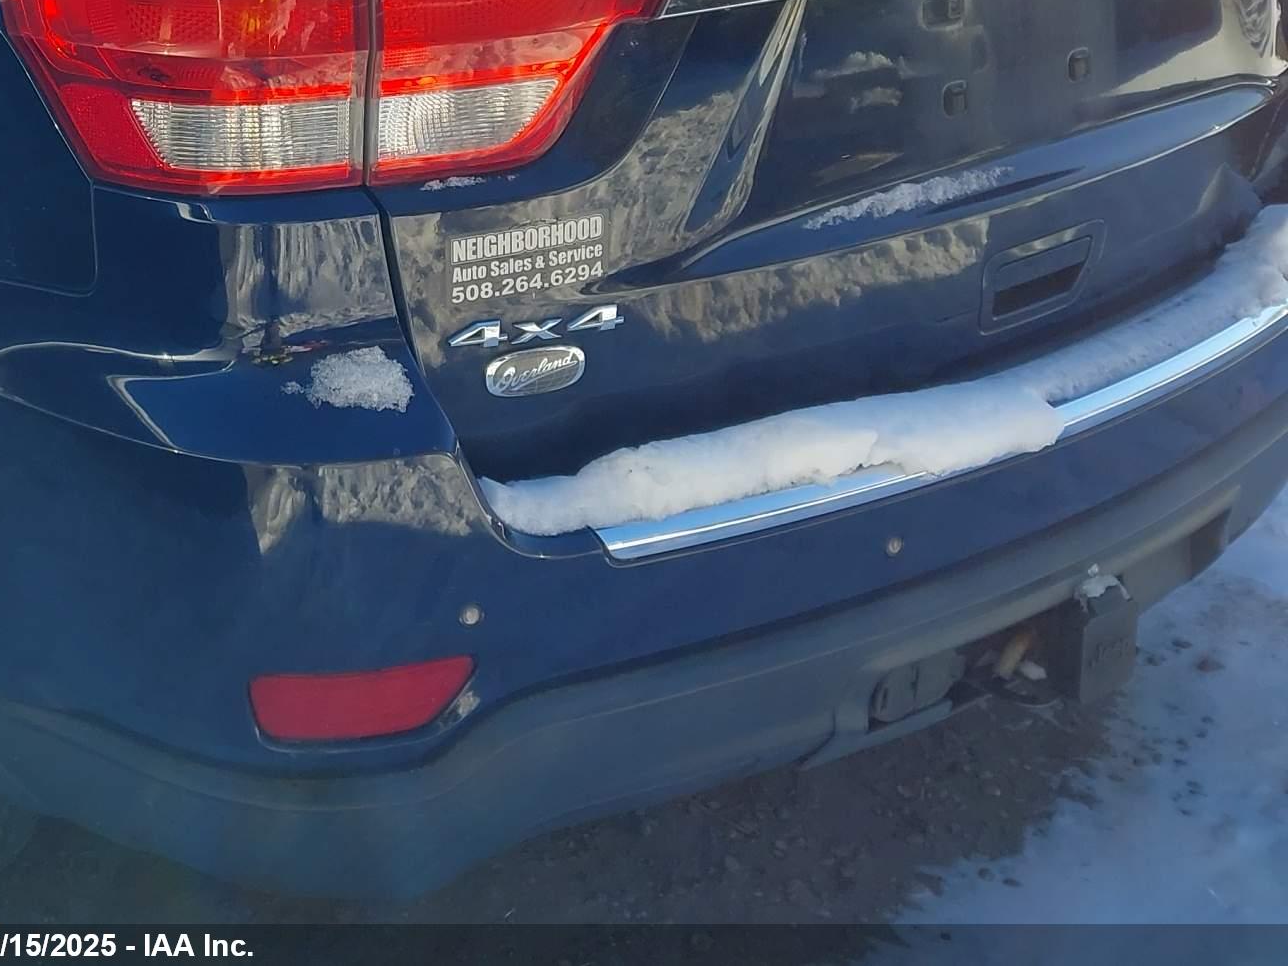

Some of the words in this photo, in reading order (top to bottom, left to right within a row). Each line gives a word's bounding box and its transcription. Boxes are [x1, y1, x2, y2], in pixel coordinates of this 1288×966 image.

[452, 215, 603, 264] NEIGHBORHOOD
[451, 261, 604, 304] 508.264.6294
[452, 265, 487, 284] Auto
[490, 257, 532, 277] Sales
[535, 255, 545, 269] &
[548, 243, 603, 267] Service
[495, 350, 578, 392] Overland
